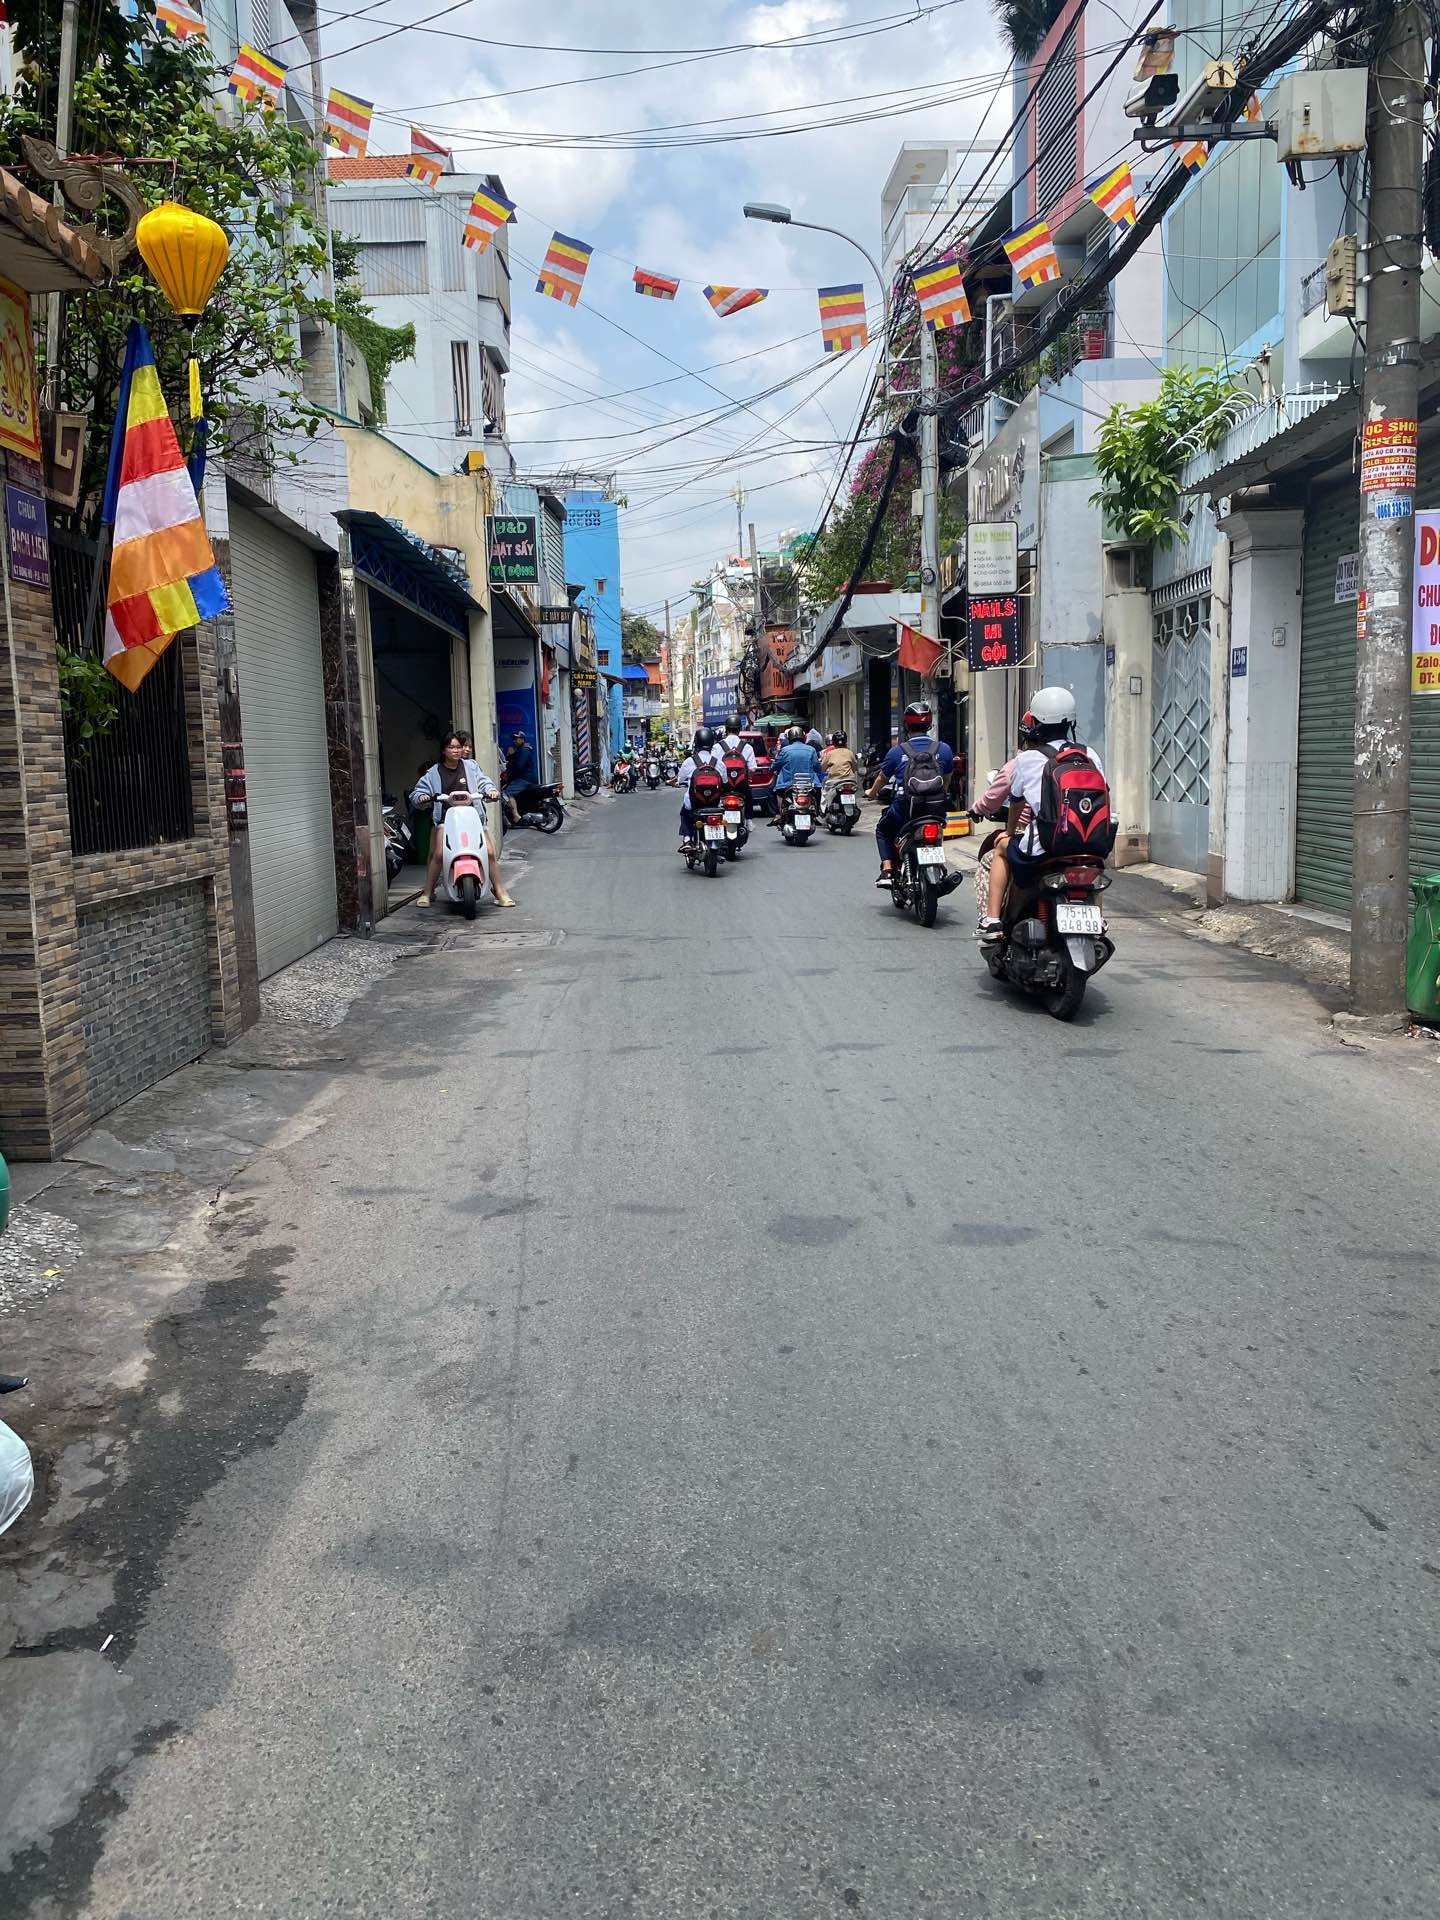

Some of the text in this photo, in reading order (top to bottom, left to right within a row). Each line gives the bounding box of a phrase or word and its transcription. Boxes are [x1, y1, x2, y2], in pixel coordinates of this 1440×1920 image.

[496, 521, 528, 535] H&D
[515, 540, 534, 556] SẤY
[971, 600, 1014, 619] NAILS
[984, 624, 1002, 640] MI
[982, 641, 1007, 664] GỘI
[1233, 649, 1246, 665] 136
